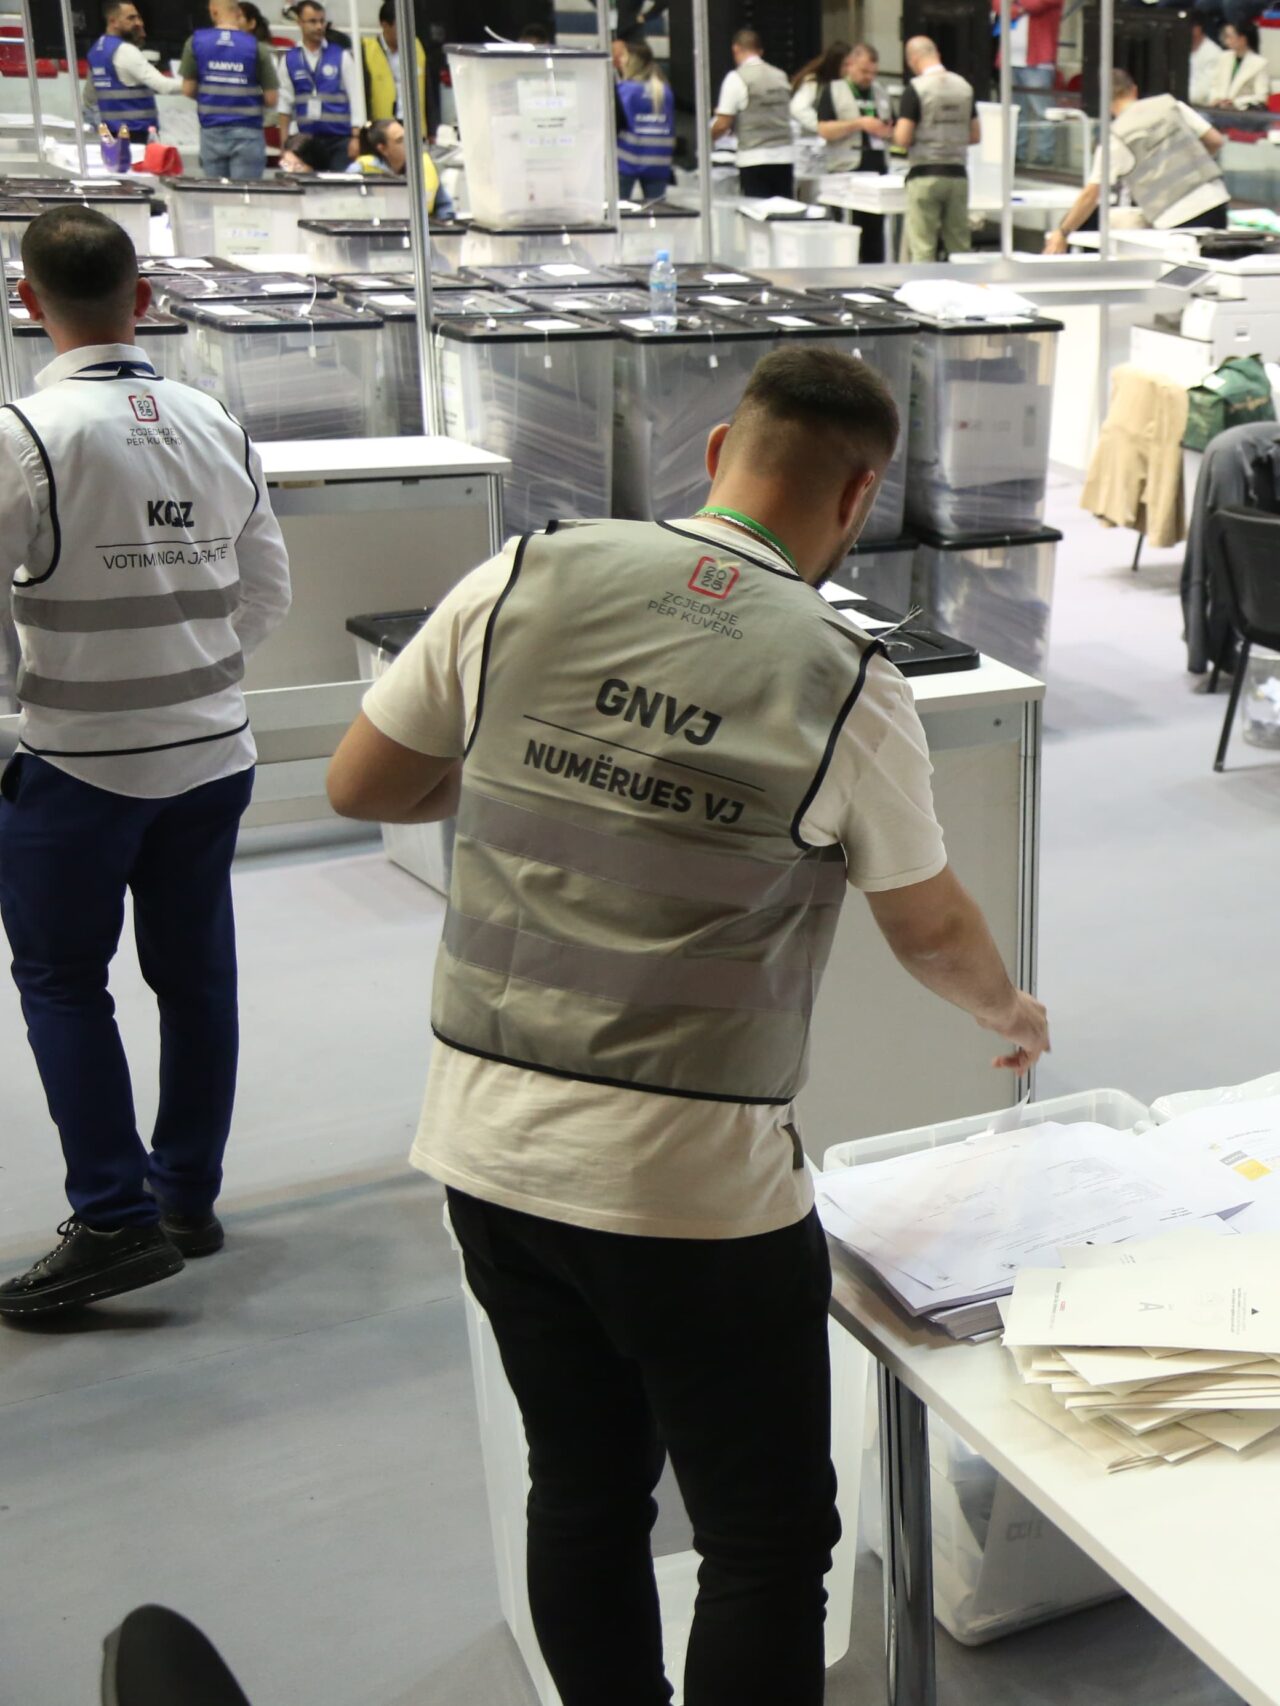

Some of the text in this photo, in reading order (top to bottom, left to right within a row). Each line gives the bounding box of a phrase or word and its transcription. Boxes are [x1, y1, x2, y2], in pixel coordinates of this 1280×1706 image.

[147, 436, 183, 446] KUEND
[147, 500, 195, 528] KQZ
[158, 550, 185, 566] NGA
[662, 591, 739, 626] ZGJEDHJE
[681, 611, 744, 640] KUVEND
[595, 678, 723, 746] GNVJ
[523, 739, 745, 825] NUMËRUES VJ
